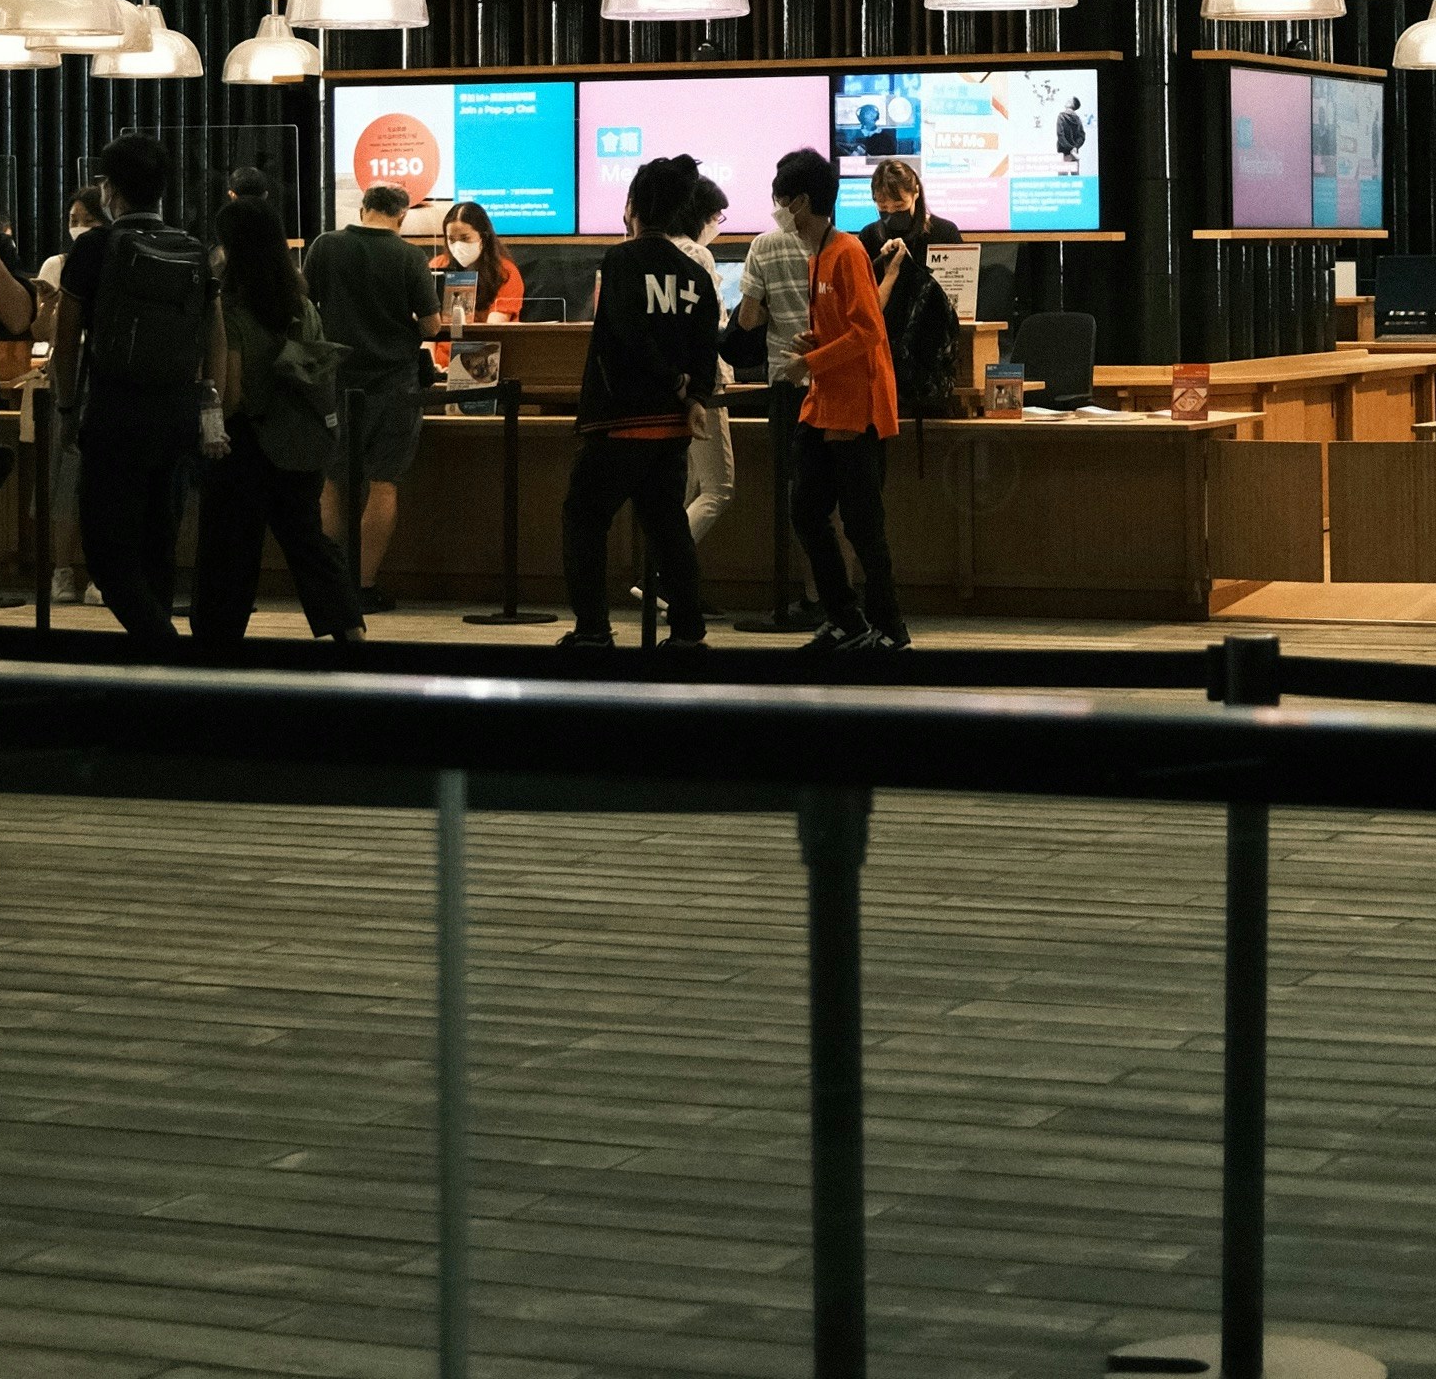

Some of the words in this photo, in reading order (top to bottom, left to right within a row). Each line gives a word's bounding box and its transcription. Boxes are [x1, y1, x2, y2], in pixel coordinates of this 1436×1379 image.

[369, 156, 424, 177] 11:30
[931, 254, 949, 263] M+
[645, 273, 701, 315] M+
